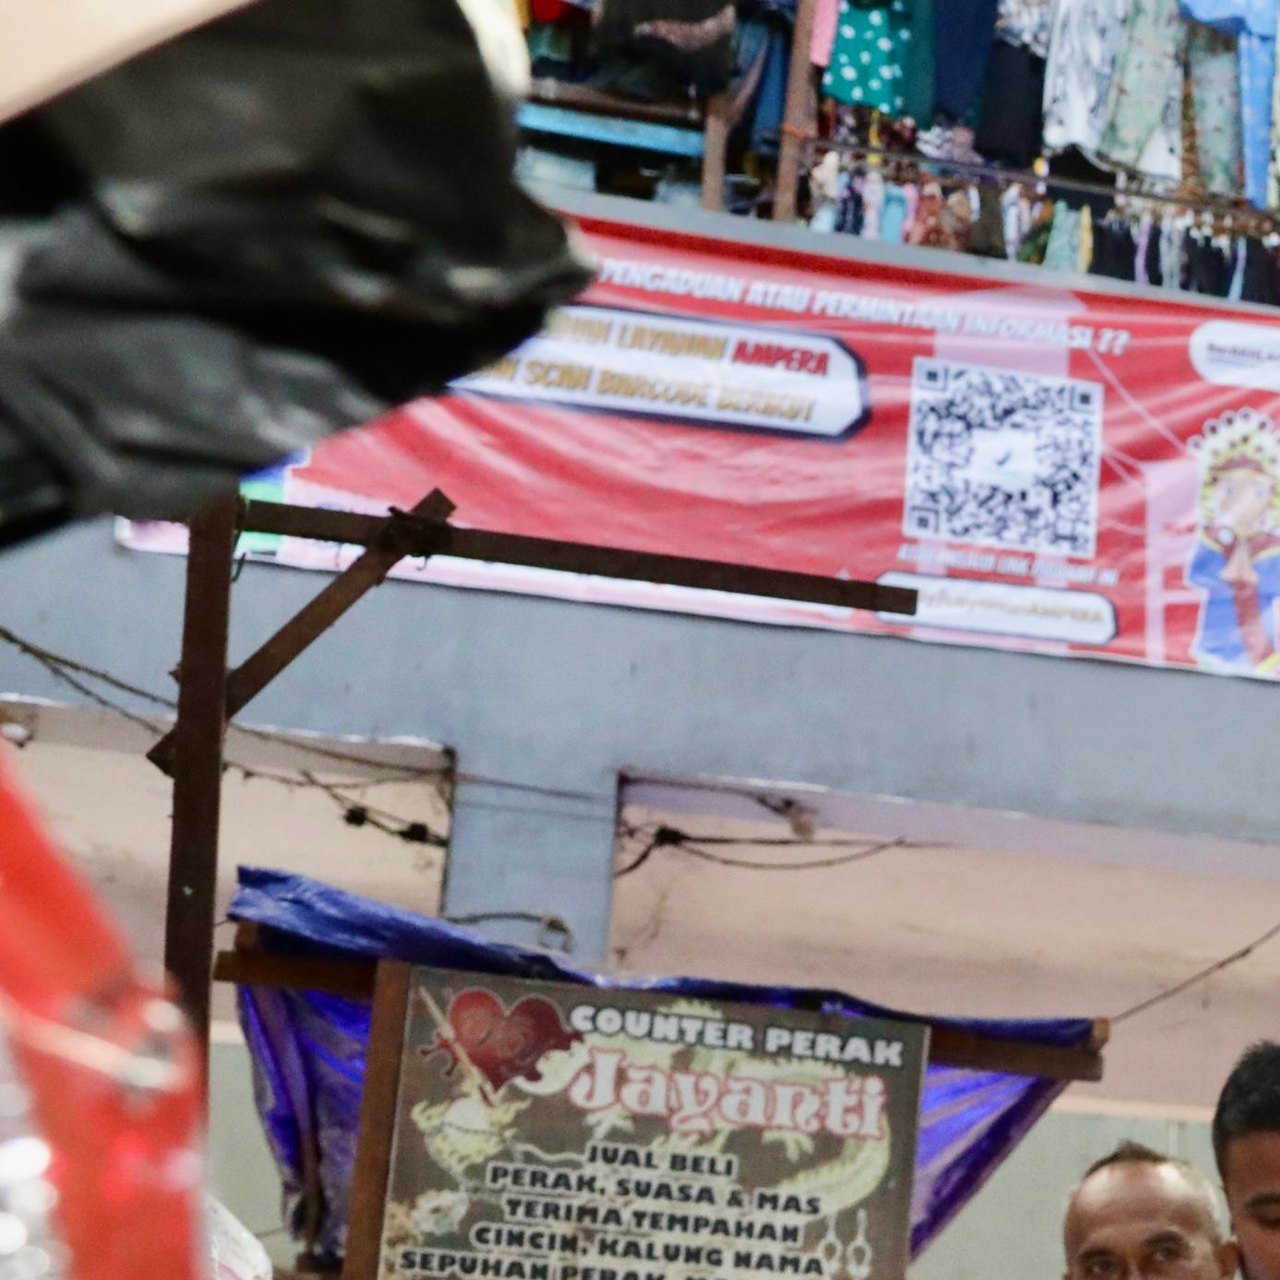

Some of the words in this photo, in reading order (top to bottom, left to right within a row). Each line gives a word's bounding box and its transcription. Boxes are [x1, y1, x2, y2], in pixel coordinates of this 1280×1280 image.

[600, 257, 745, 302] PENGADUAN
[745, 279, 811, 313] ATAU
[732, 339, 829, 377] AMPERA
[570, 1005, 754, 1050] COUNTER
[765, 1027, 903, 1067] PERAK
[568, 1048, 887, 1139] Jayanti
[588, 1145, 658, 1170] JUAL
[669, 1153, 734, 1177] BELI
[616, 1178, 715, 1205] SUASA
[727, 1188, 744, 1208] &
[757, 1191, 821, 1215] MAS
[506, 1198, 623, 1226] TERIMA
[632, 1210, 799, 1243] TEMPAHAN
[400, 1251, 549, 1280] SEPUHAN
[598, 1237, 723, 1266] KALUNG
[734, 1251, 823, 1276] NAMA
